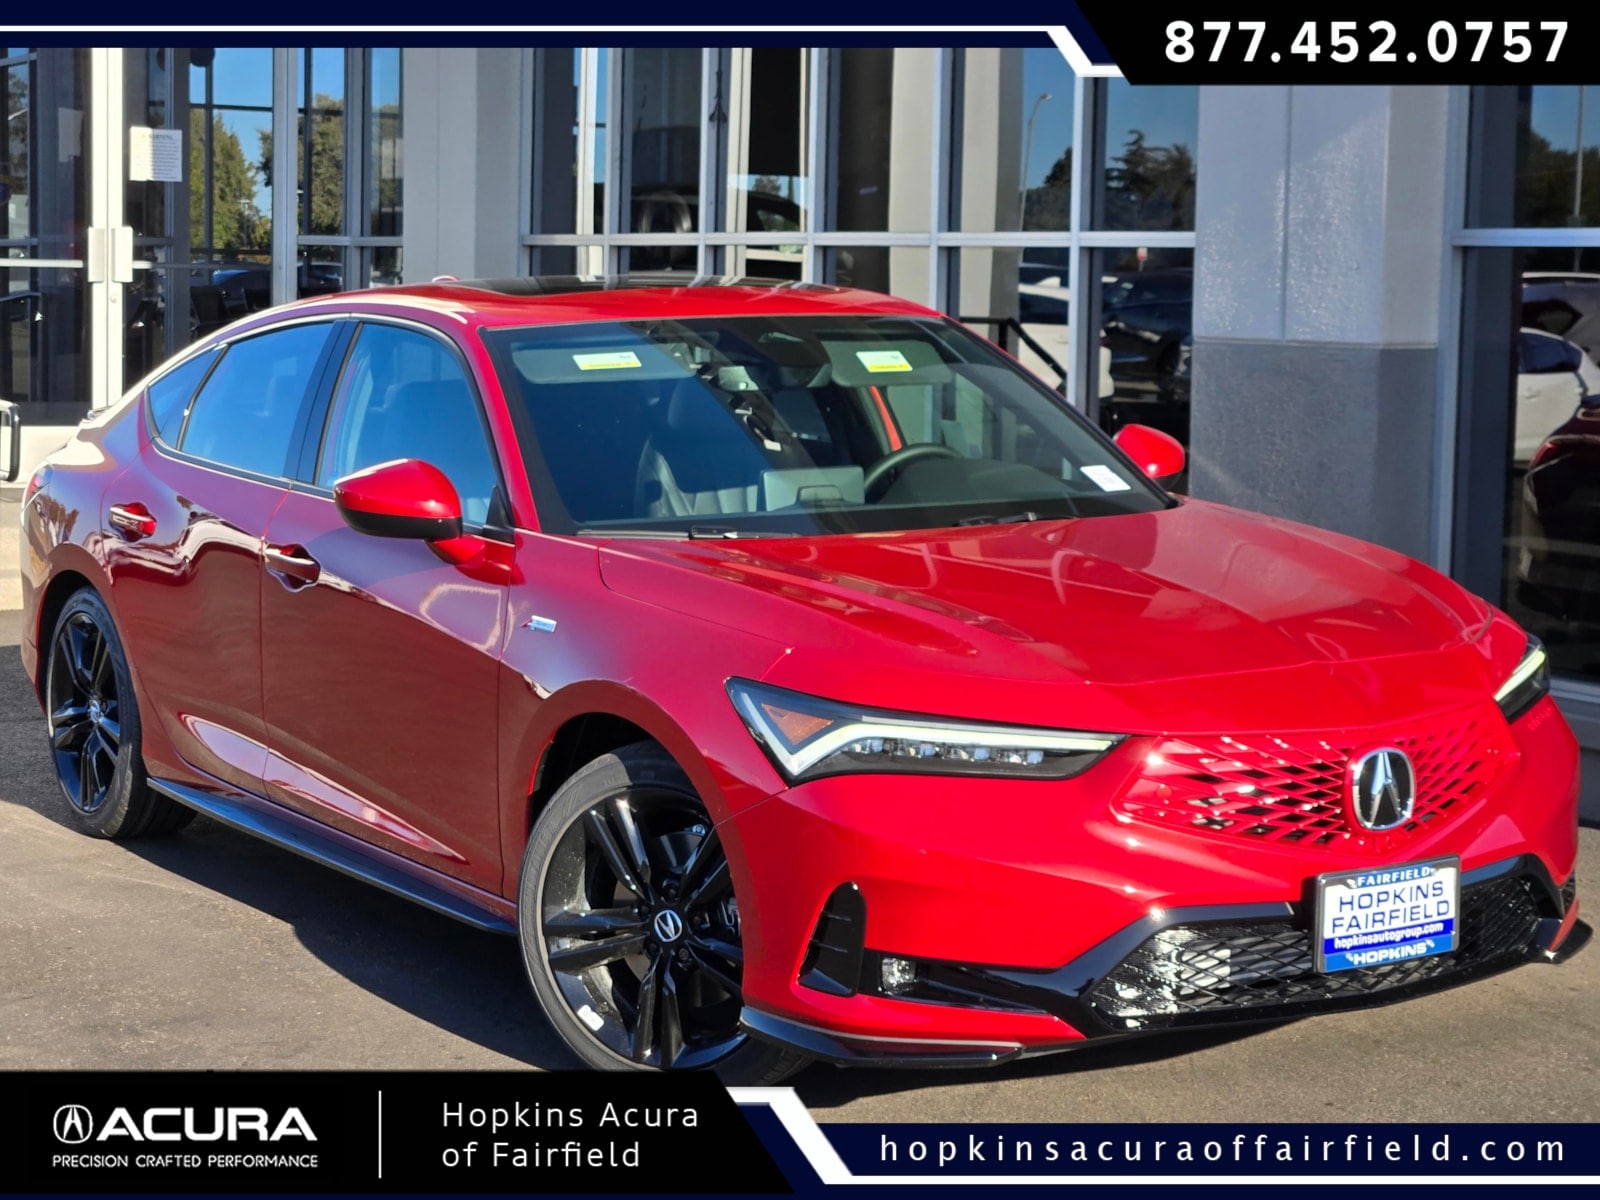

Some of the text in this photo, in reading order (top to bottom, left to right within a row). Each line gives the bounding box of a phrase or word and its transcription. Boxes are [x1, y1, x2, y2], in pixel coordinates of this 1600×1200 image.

[1357, 866, 1431, 887] FAIRFIELD
[1339, 881, 1444, 912] HOPKINS
[1332, 900, 1450, 934] FAIRFIELD
[1334, 922, 1444, 949] hopkinsautogroup.com
[1353, 942, 1428, 965] HOPKINS
